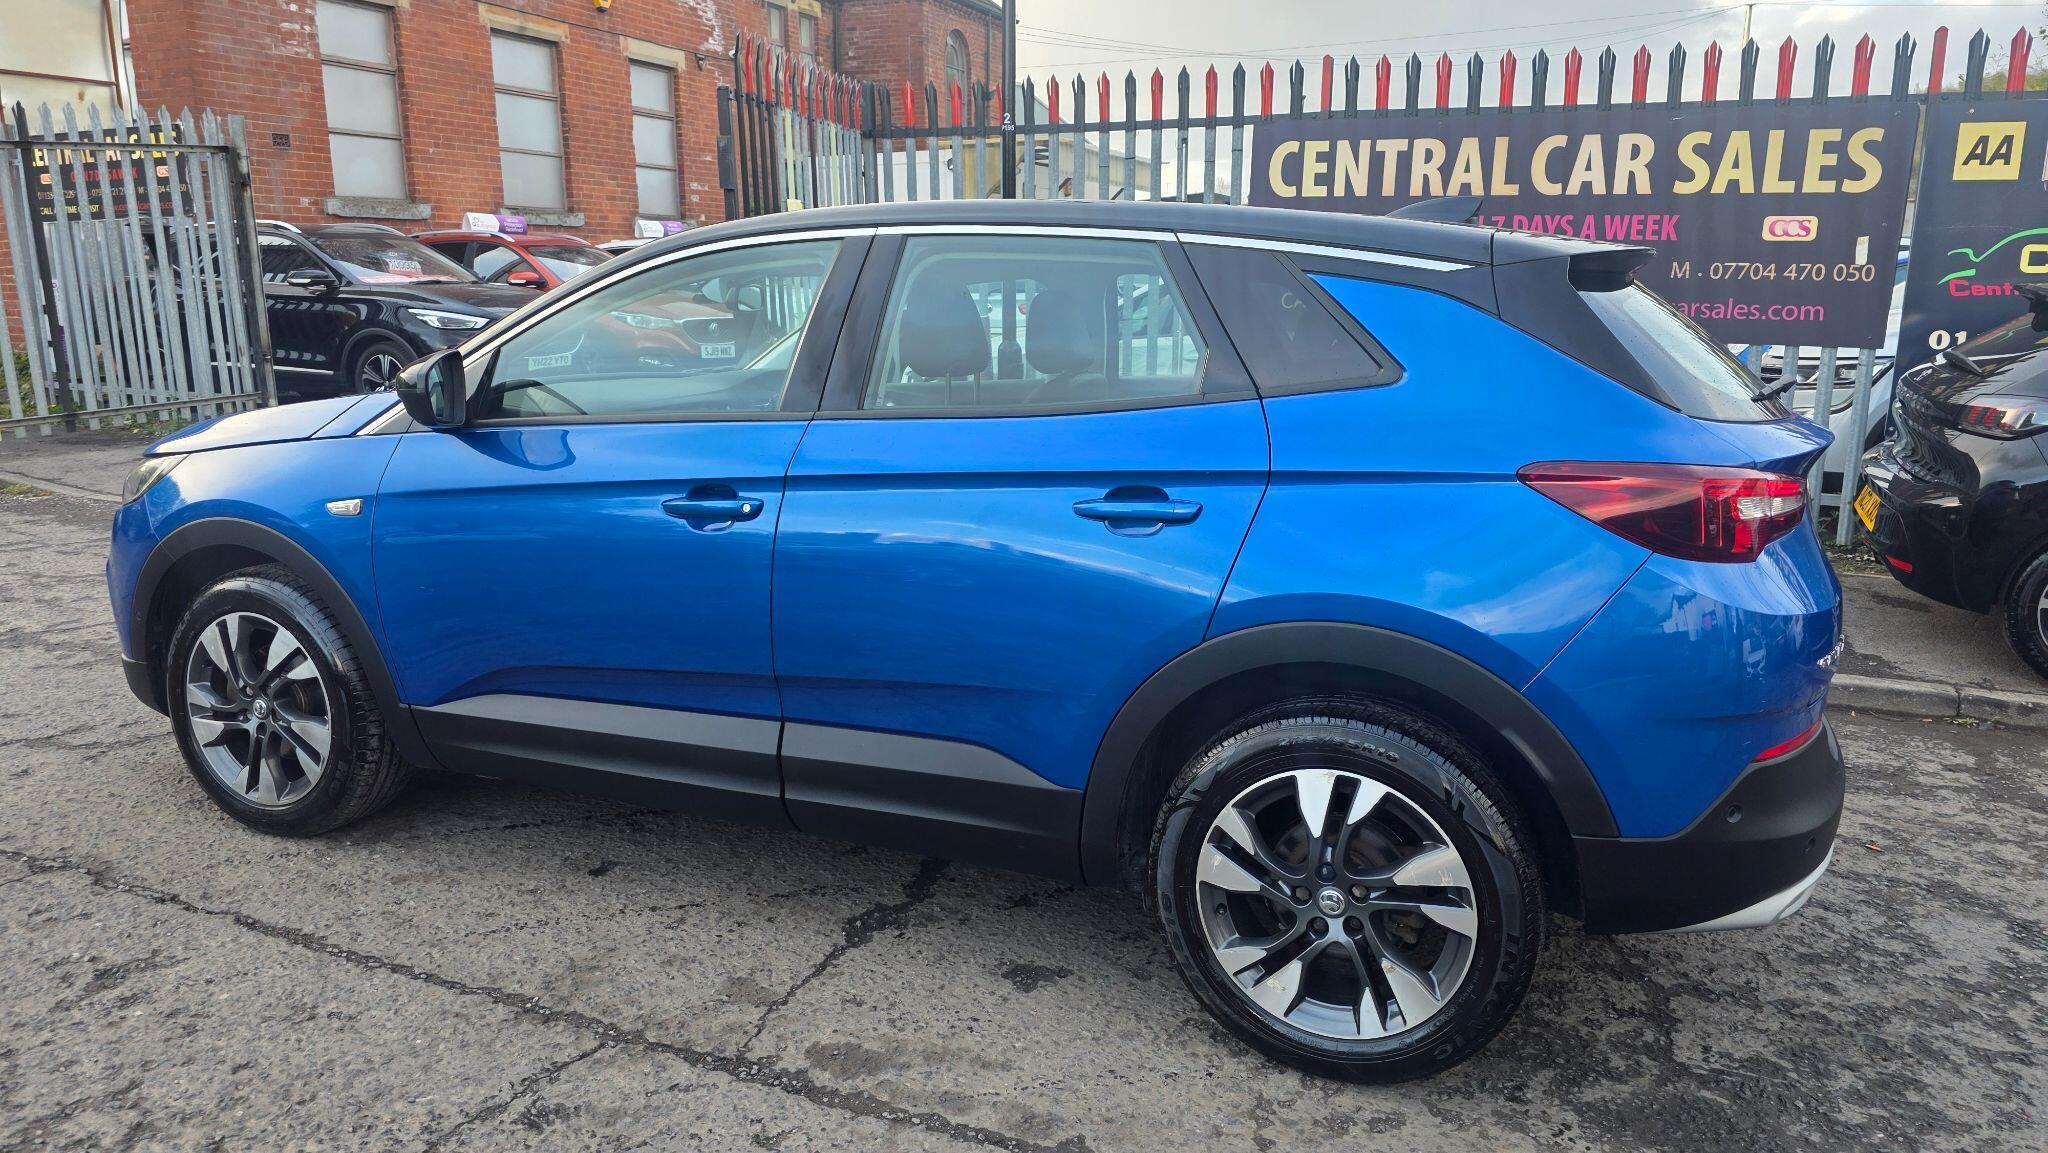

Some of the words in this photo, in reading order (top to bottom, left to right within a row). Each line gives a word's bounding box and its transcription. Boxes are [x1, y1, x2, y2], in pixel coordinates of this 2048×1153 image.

[1268, 136, 1520, 198] CENTRAL
[1530, 133, 1655, 196] CAR
[1672, 127, 1885, 195] SALES
[1961, 134, 2016, 166] AA
[1492, 215, 1506, 229] 7
[1512, 214, 1574, 239] DAYS
[1580, 215, 1596, 240] A
[1604, 214, 1681, 241] WEEK
[1768, 219, 1812, 238] CCS
[1709, 262, 1776, 281] 07704
[1783, 262, 1826, 281] 470
[1833, 263, 1876, 282] 050
